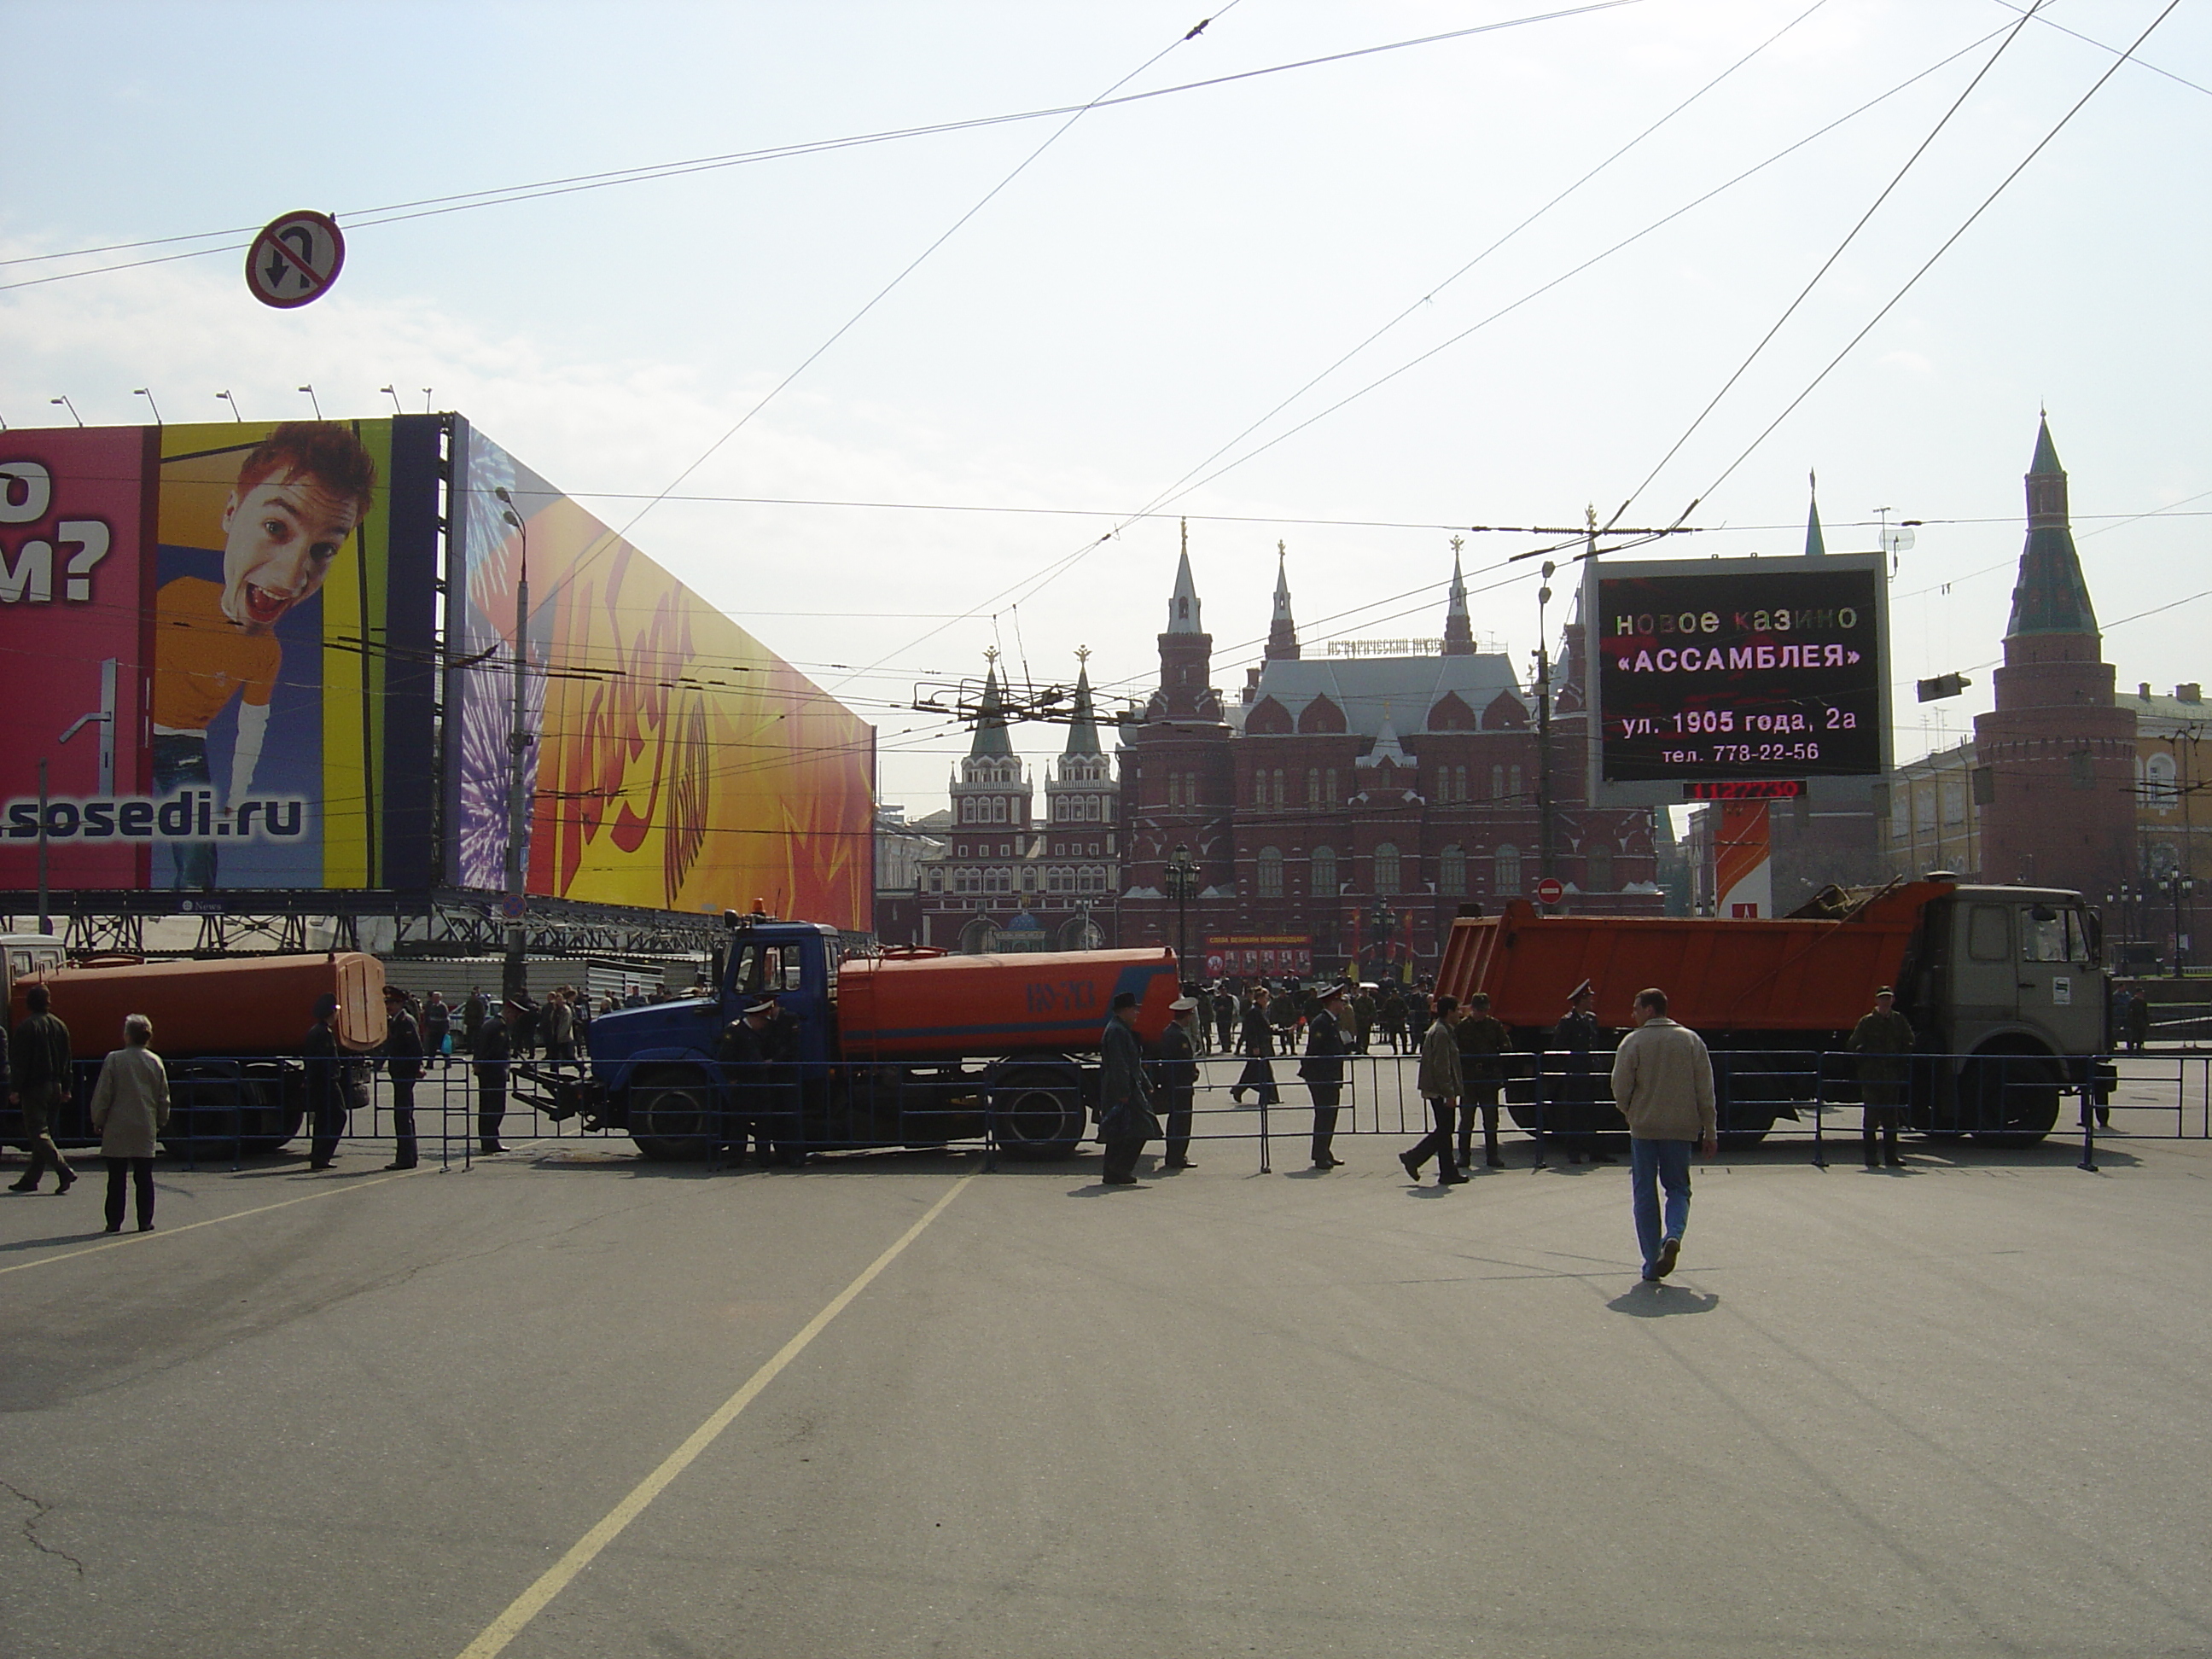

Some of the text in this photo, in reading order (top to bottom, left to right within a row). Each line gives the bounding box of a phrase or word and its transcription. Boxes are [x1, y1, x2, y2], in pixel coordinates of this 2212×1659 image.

[1616, 607, 1858, 636] новое казино
[1617, 643, 1861, 673] «АССАМБЛЕЯ»
[1622, 707, 1857, 739] ул. 1905 года, 2а
[1662, 742, 1819, 764] тел. 778-22-56
[0, 790, 301, 837] sosedi.ru
